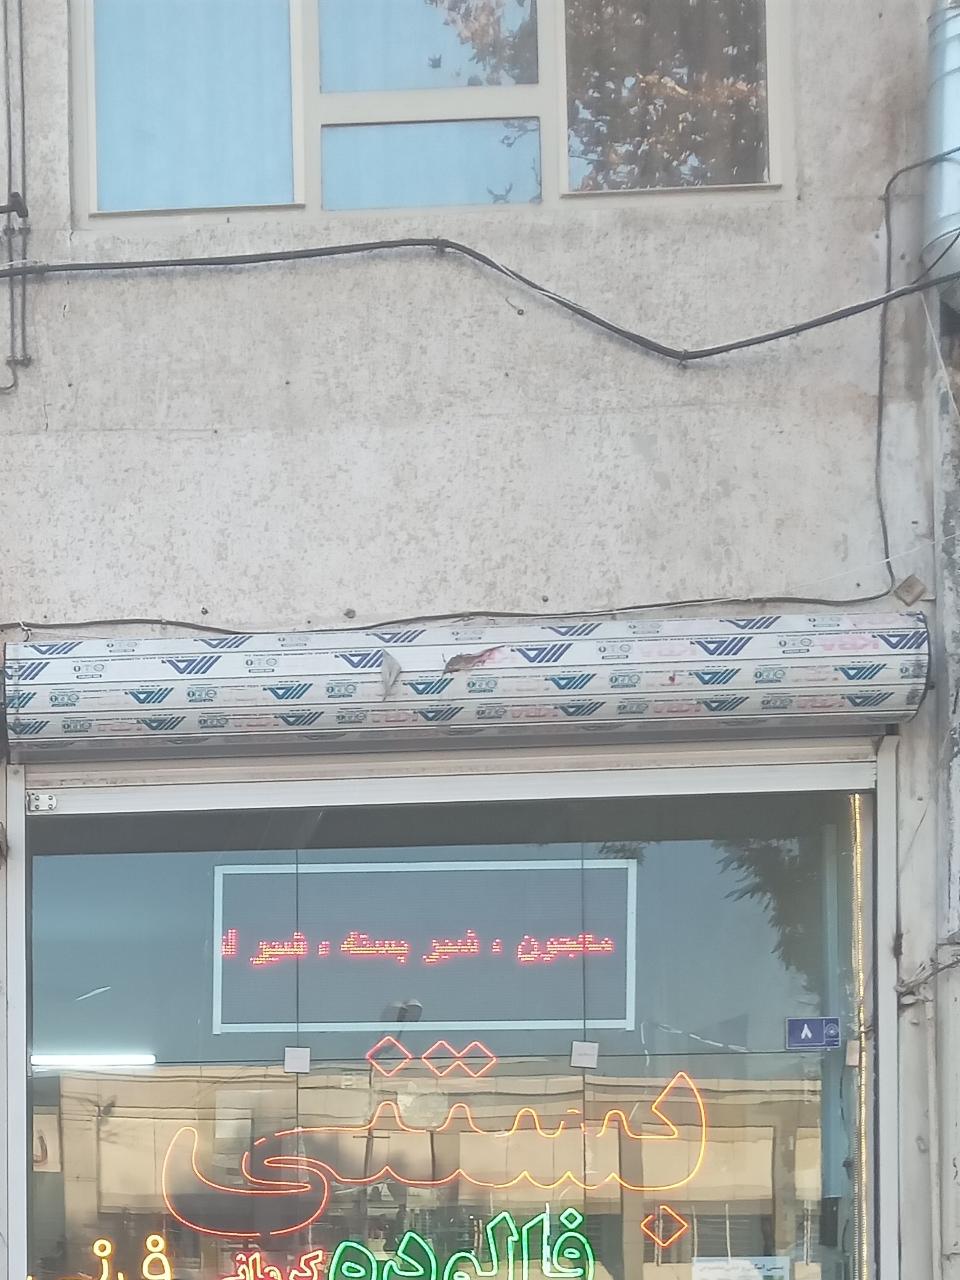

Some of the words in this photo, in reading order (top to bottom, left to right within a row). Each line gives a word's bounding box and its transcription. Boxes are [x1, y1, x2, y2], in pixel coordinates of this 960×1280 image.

[249, 931, 308, 965] شیر
[340, 930, 409, 963] پسته
[422, 929, 480, 963] شیر
[800, 1023, 813, 1040] ۸
[162, 1036, 707, 1248] بستنی
